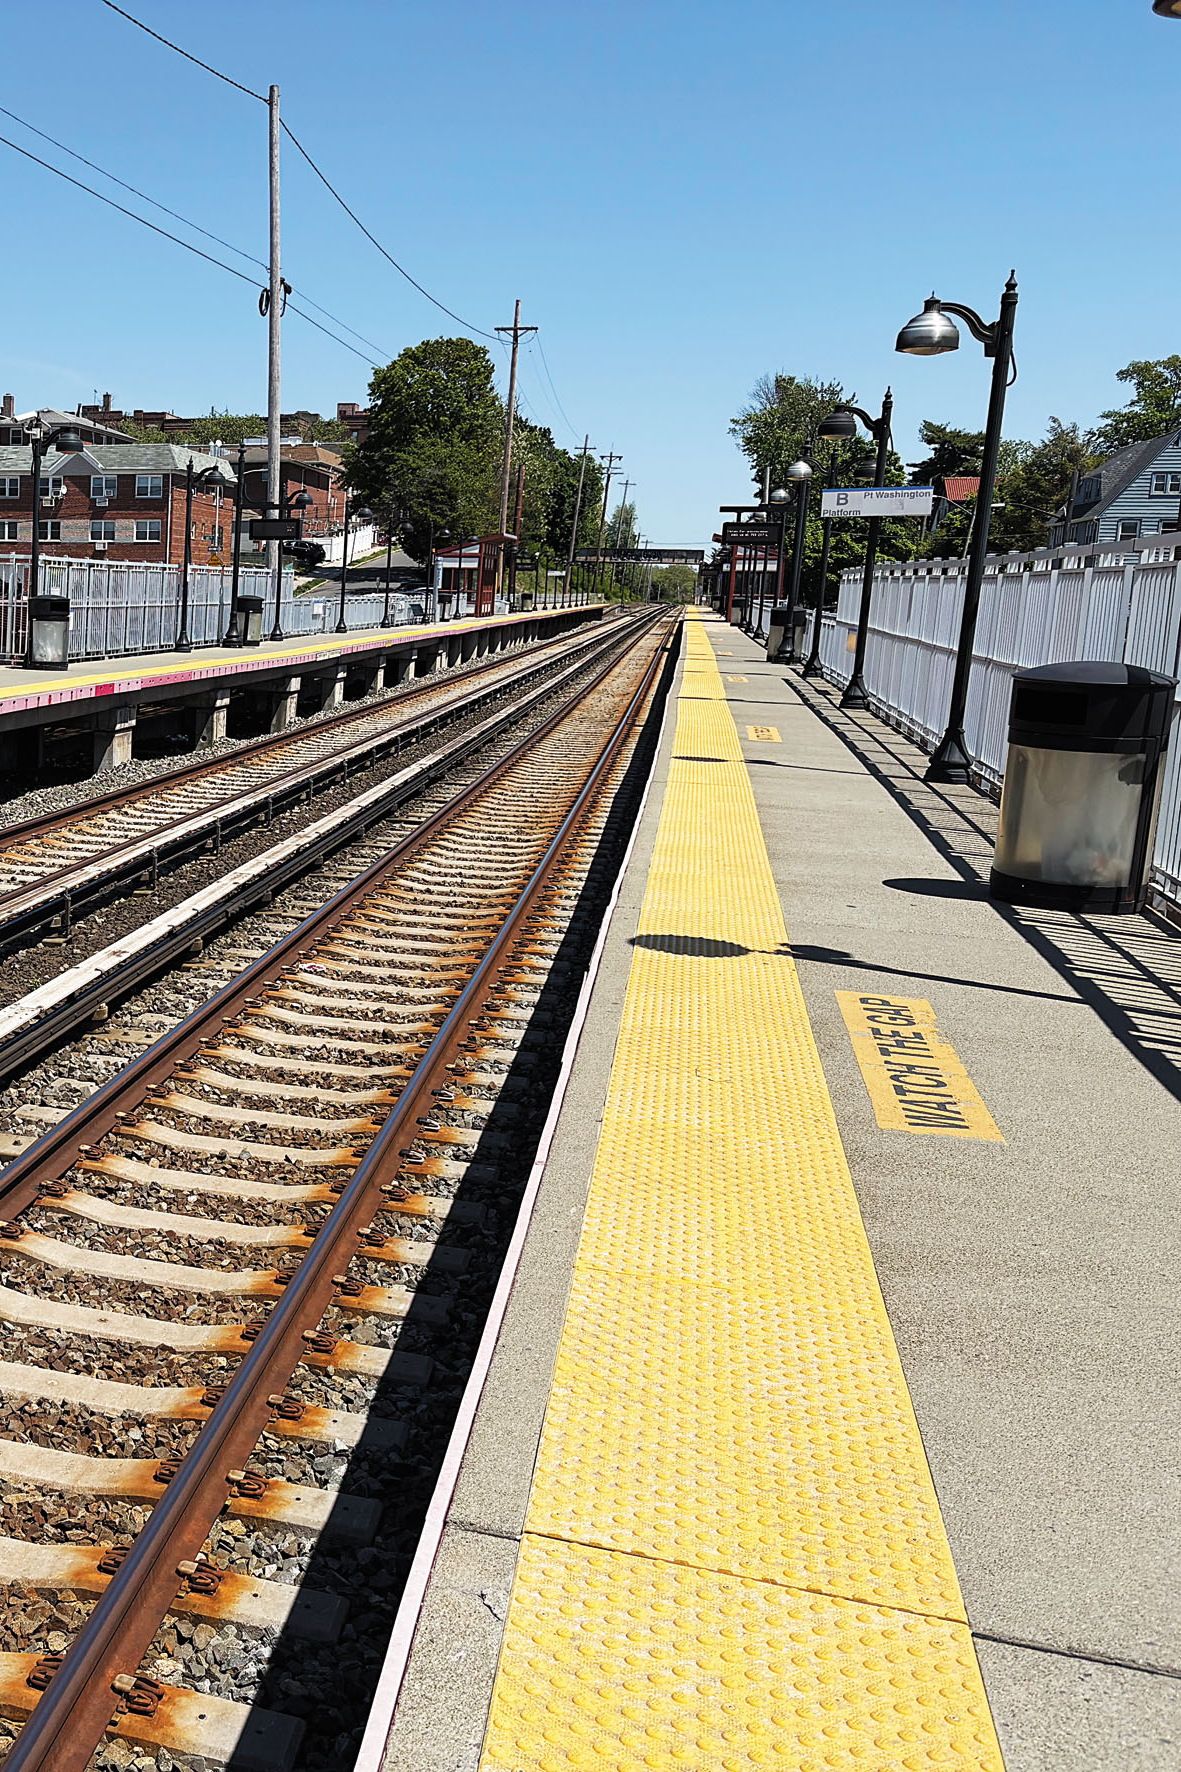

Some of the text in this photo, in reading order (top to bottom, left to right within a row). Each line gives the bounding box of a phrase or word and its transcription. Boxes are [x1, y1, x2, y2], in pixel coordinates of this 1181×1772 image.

[836, 492, 849, 506] B
[863, 490, 931, 500] Pt Washington
[822, 508, 861, 517] Platform
[859, 997, 970, 1129] WATCH THE GAP
